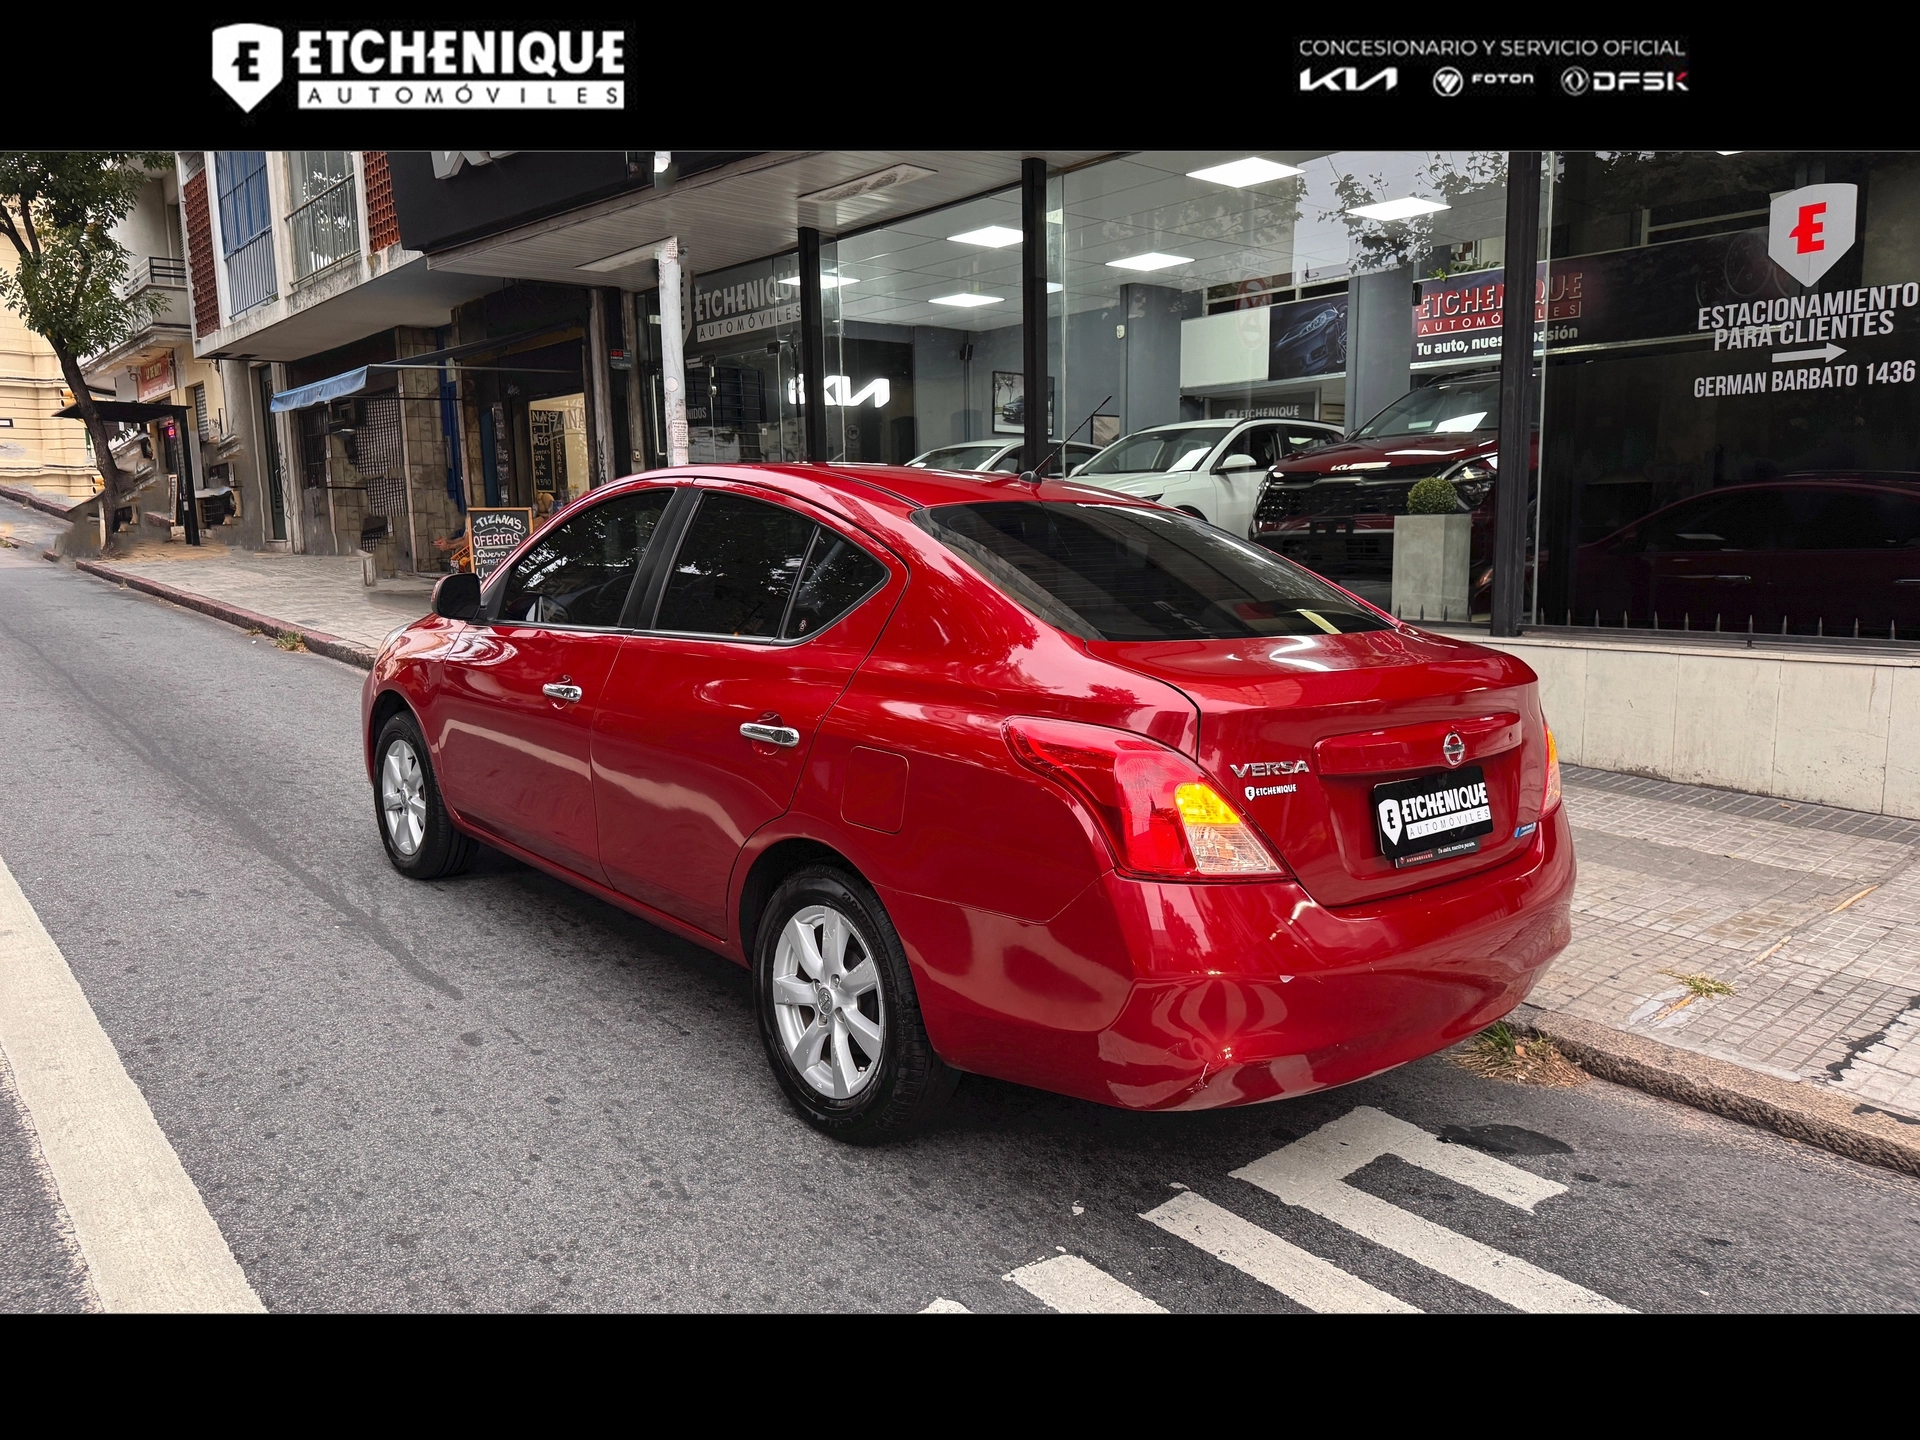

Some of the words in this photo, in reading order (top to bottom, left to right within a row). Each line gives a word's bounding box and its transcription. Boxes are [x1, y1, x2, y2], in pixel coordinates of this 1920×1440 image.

[1698, 282, 1919, 331] ESTACIONAMIENTO
[1421, 306, 1577, 334] AUTOMÓLES
[1714, 325, 1774, 352] PARA
[1779, 310, 1895, 345] CLIENTES
[1417, 343, 1432, 356] Tu
[1434, 338, 1469, 355] auto,
[1471, 336, 1503, 350] nues
[1693, 372, 1767, 398] GERMAN
[1771, 364, 1858, 393] BARBATO
[1866, 359, 1916, 385] 1436
[1239, 405, 1299, 419] ETCHENIQUE
[476, 514, 522, 530] TIZANA'S
[474, 533, 521, 547] OFERTAS
[1229, 760, 1310, 778] VERSA
[1255, 784, 1297, 796] ETCHENIQUE
[1401, 782, 1488, 822] ETCHENIQUE
